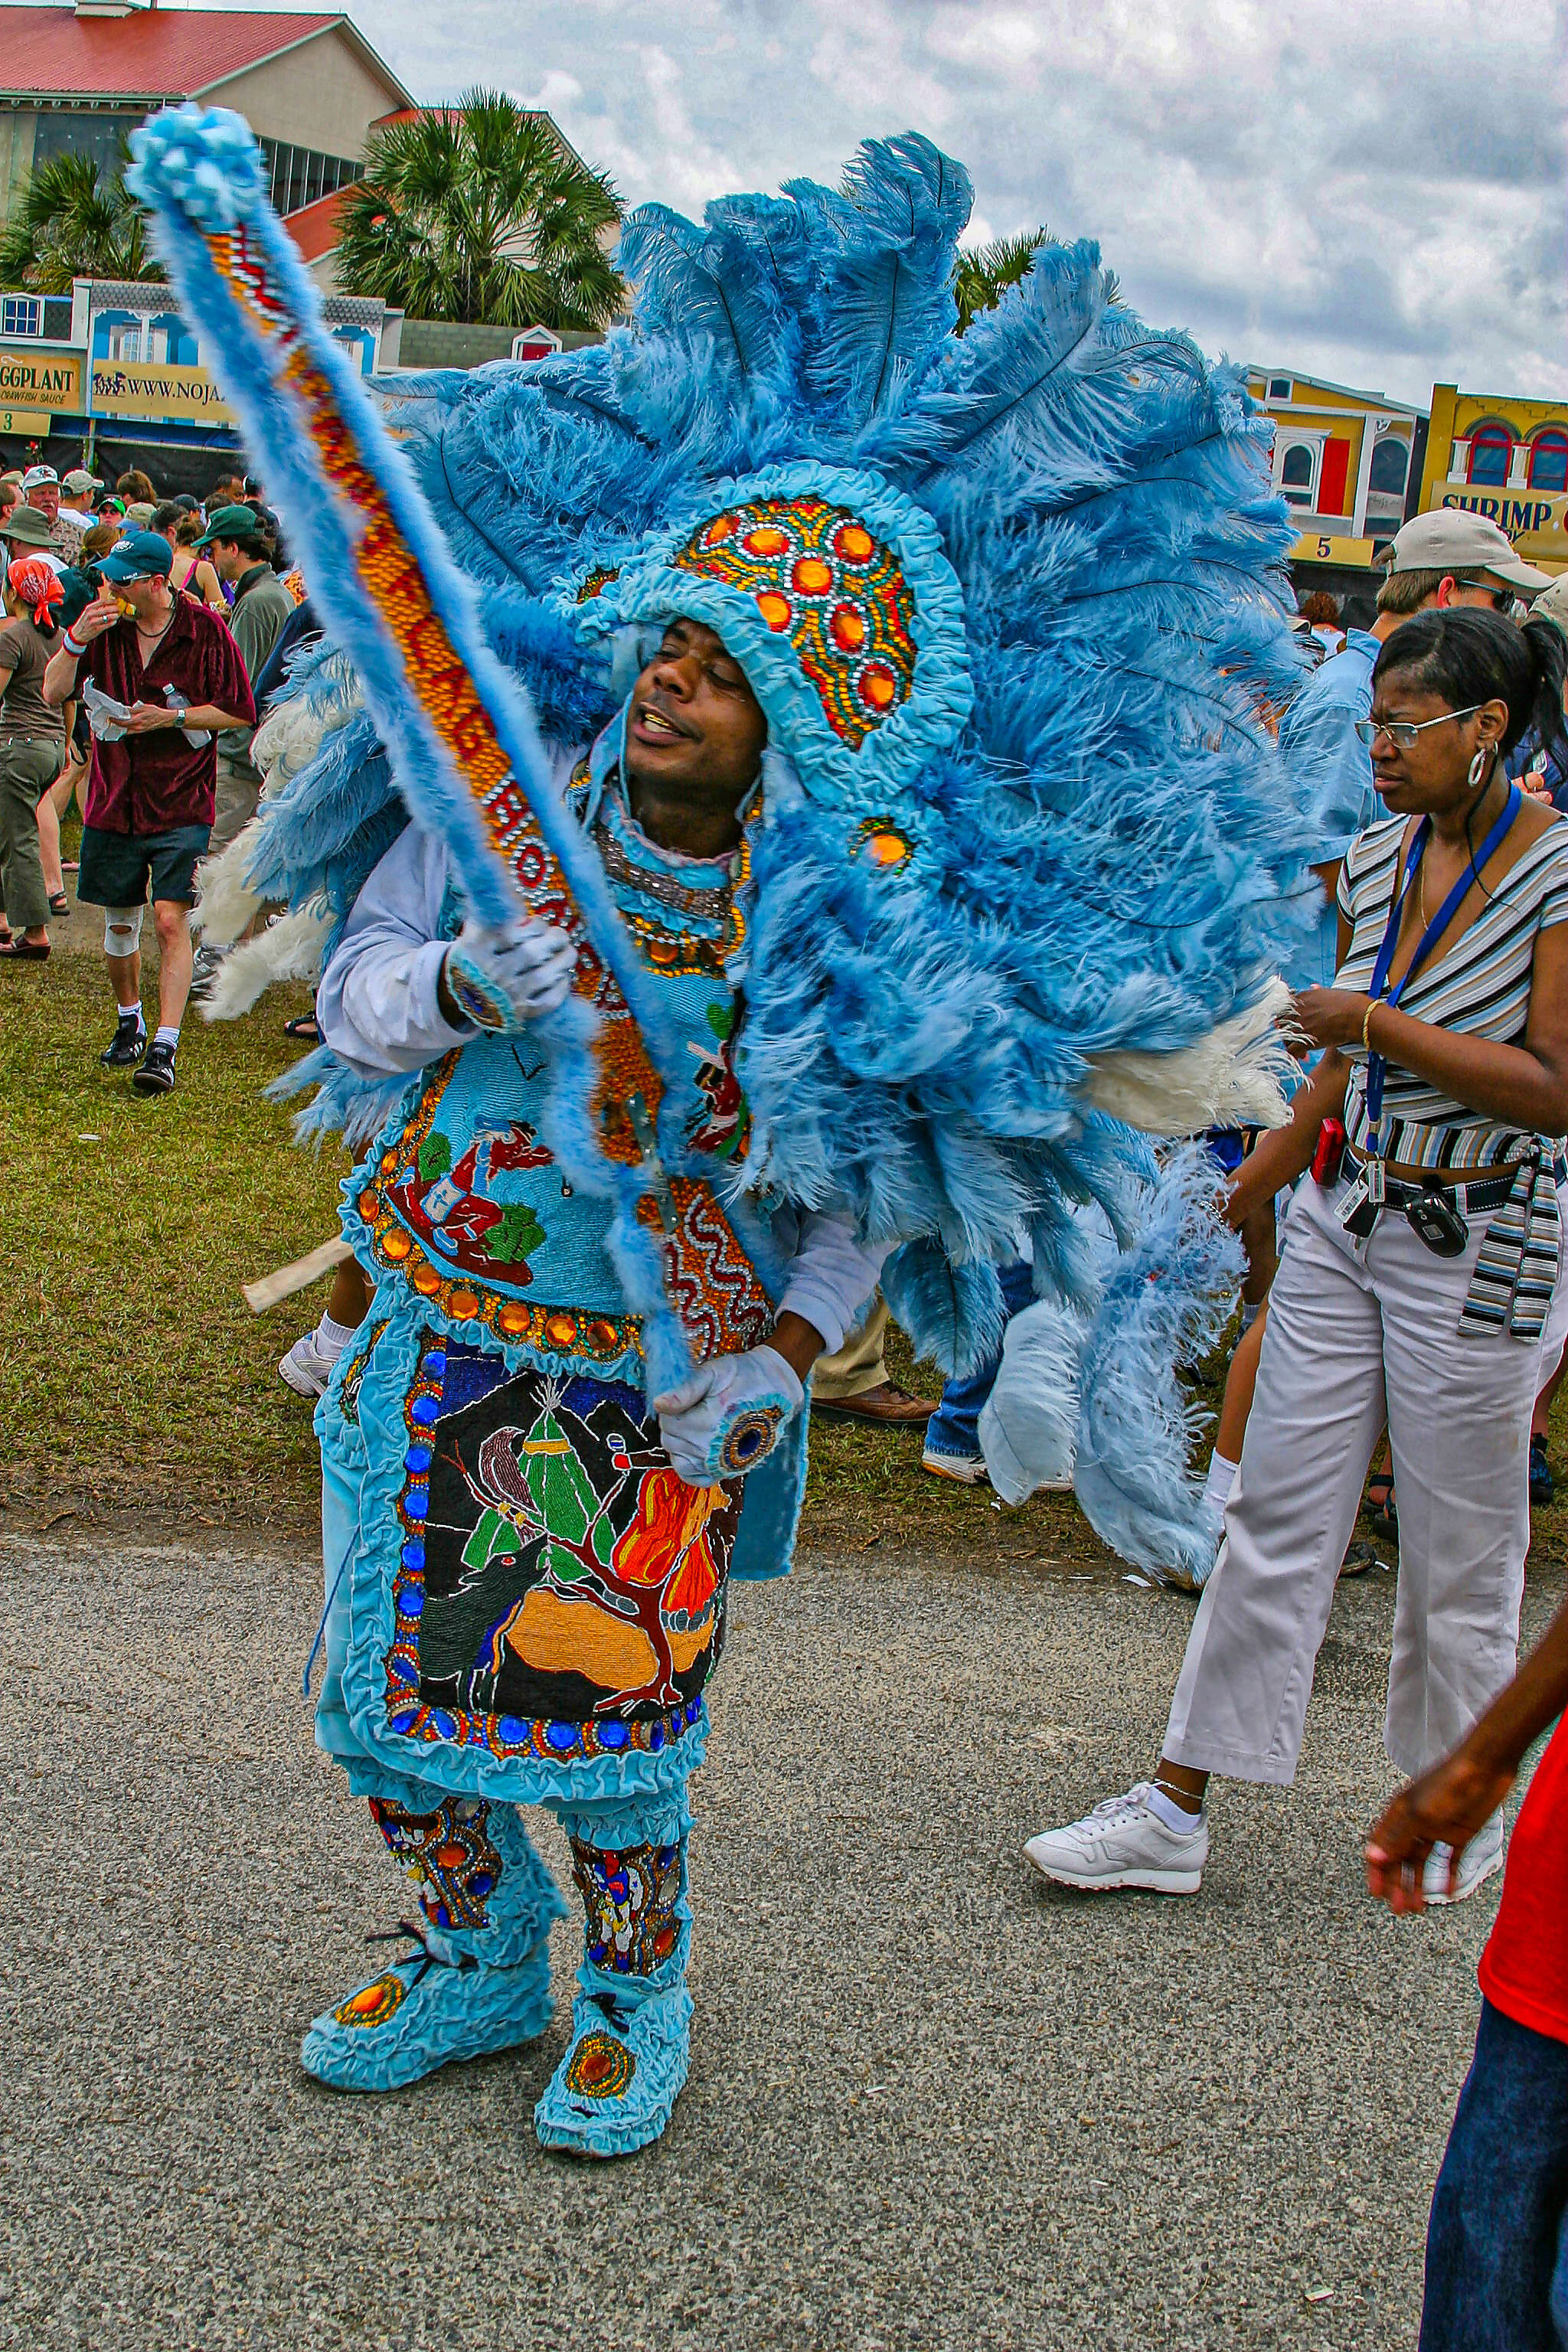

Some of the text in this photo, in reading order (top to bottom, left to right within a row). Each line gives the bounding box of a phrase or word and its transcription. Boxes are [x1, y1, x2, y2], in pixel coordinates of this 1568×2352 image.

[39, 393, 67, 405] SAUCE
[127, 378, 225, 405] WWW.NOJA
[3, 413, 13, 431] 3
[1442, 493, 1552, 531] SHRIMP
[1316, 536, 1331, 558] 5
